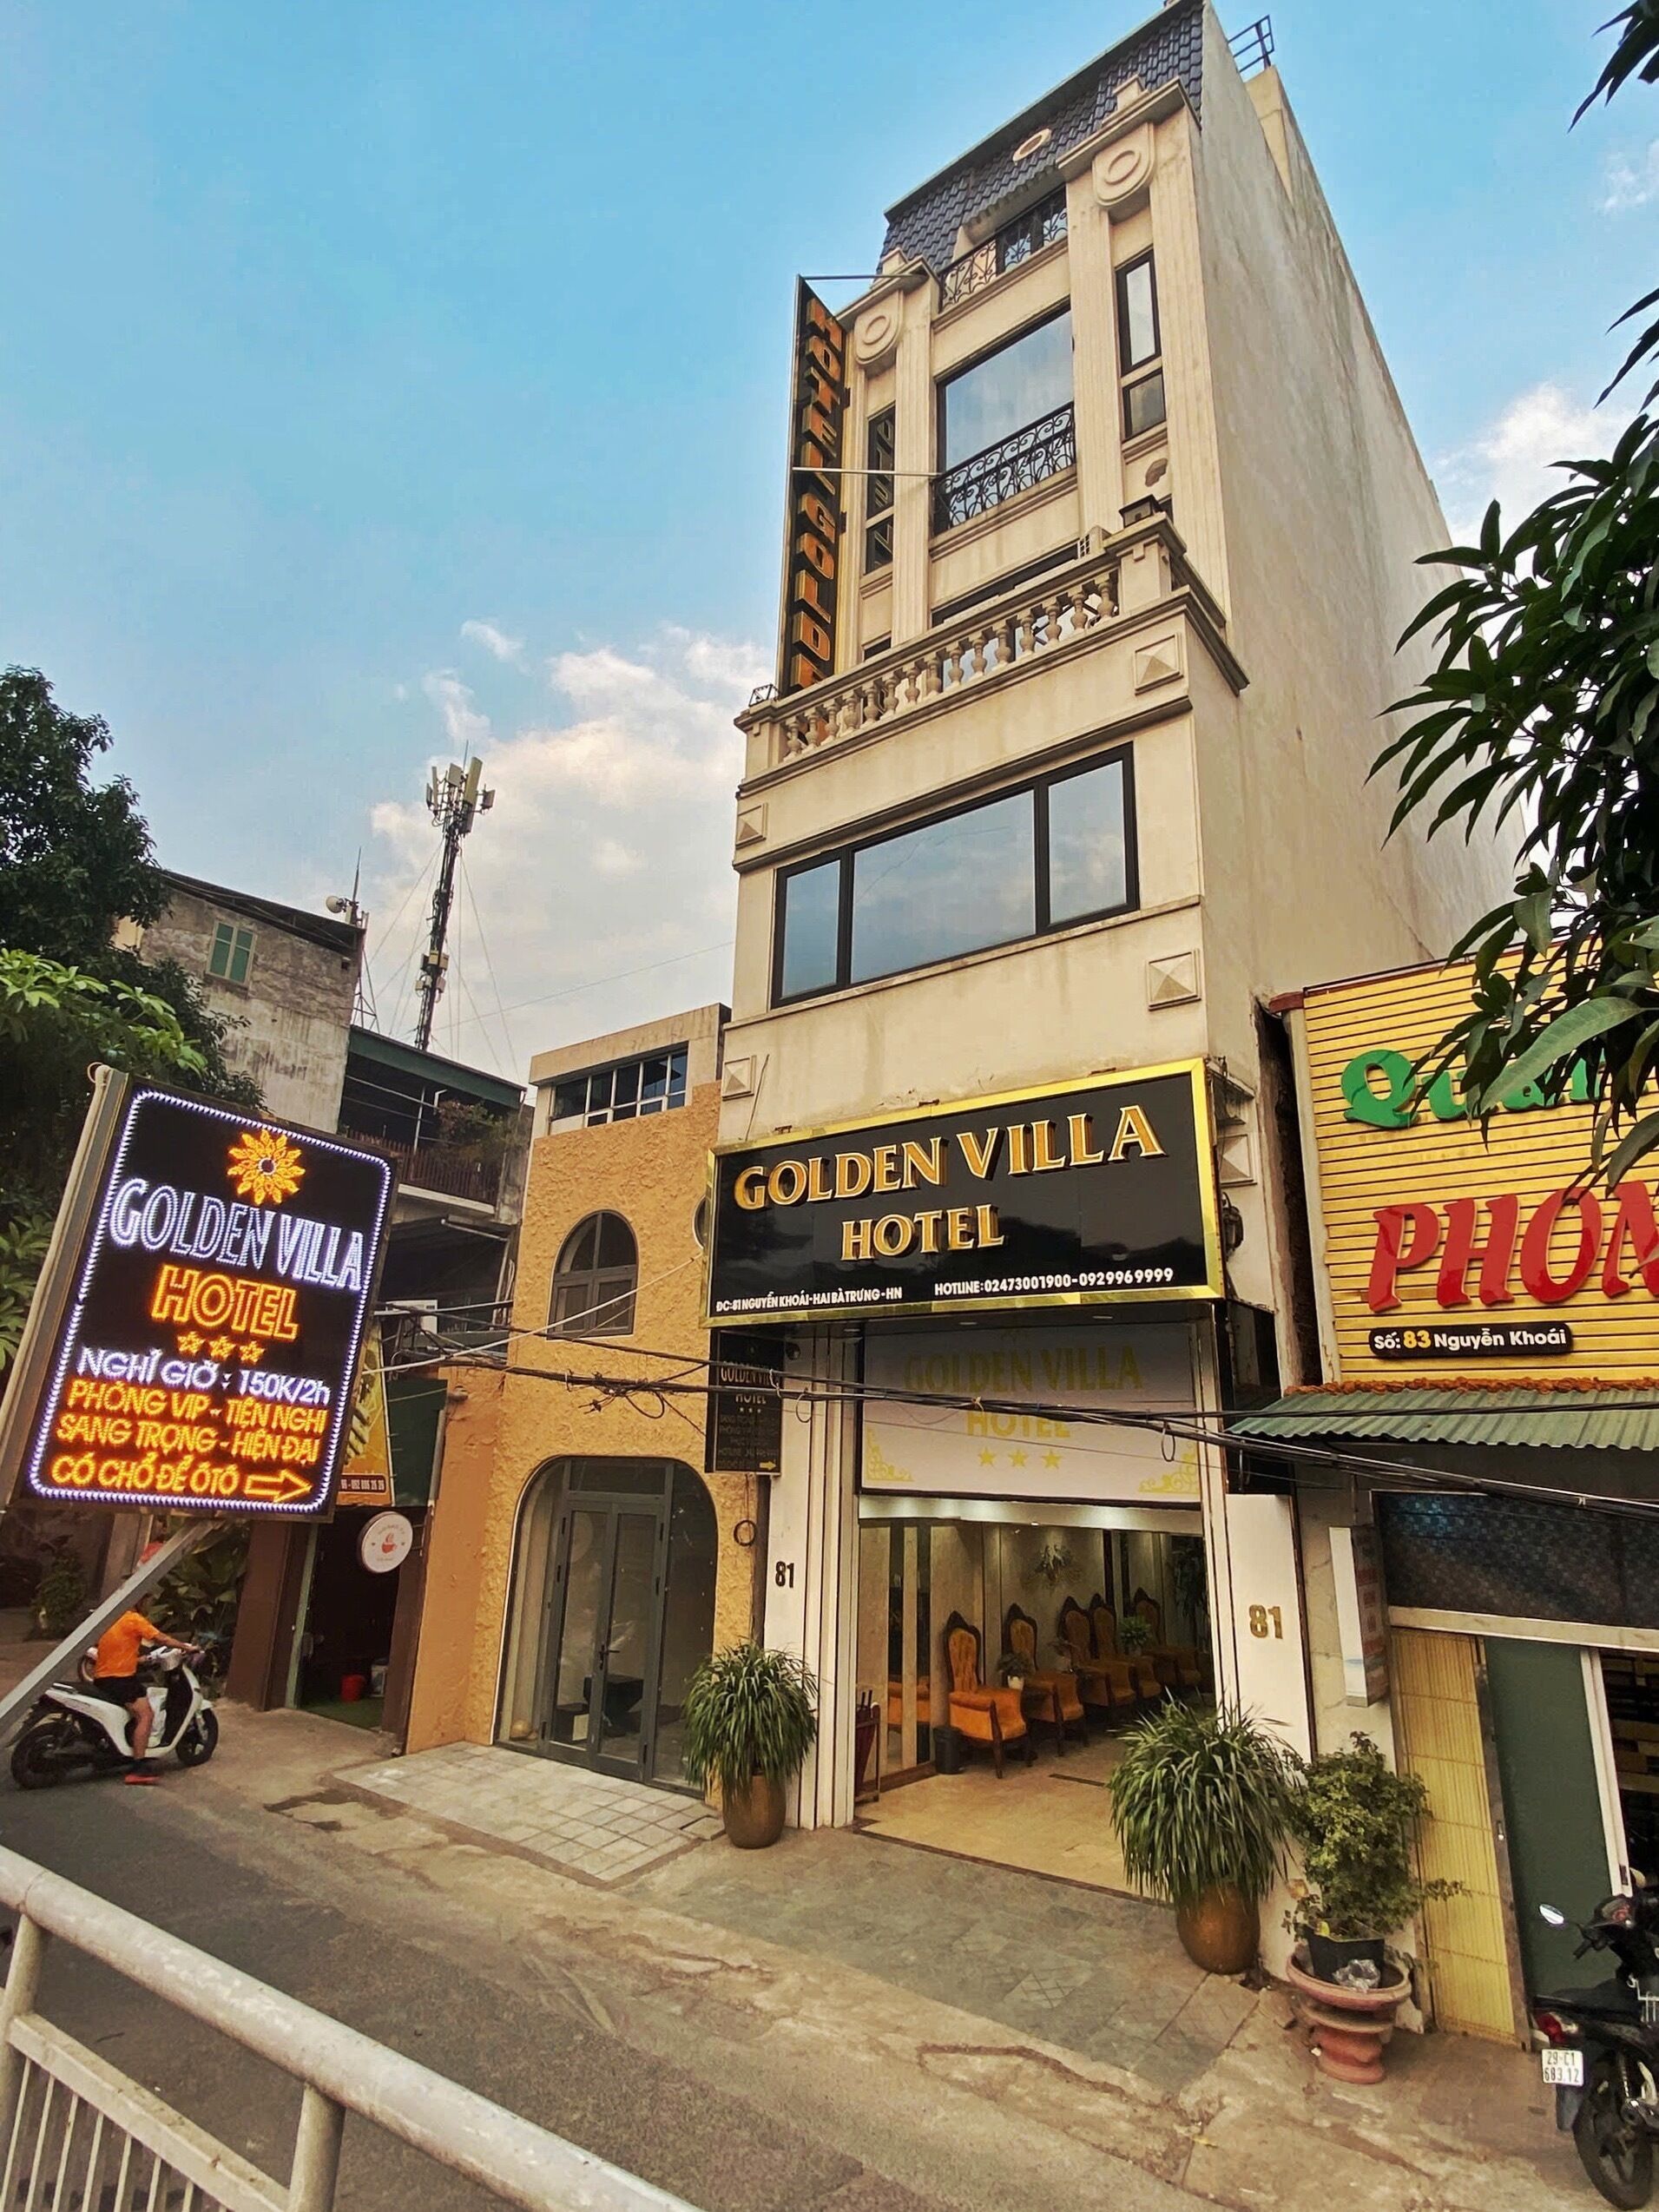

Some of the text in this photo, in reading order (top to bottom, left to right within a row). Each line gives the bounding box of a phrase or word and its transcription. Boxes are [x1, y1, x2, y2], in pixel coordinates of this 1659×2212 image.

[801, 298, 842, 496] HOTEL
[734, 1105, 1167, 1211] GOLDEN VILLA
[109, 1178, 364, 1291] GOLDEN VILLA
[840, 1204, 1005, 1261] HOTEL
[150, 1264, 299, 1340] HOTEL
[1373, 1328, 1567, 1351] Số: 83 Nguyễn Khoái
[239, 1369, 332, 1406] 150K/2h
[903, 1345, 1144, 1392] GOLDEN VILLA
[171, 1392, 211, 1421] VIP
[966, 1407, 1071, 1438] HOTEL
[56, 1413, 132, 1446] SANG
[135, 1420, 219, 1457] TRỌNG
[51, 1452, 95, 1485] CÓ
[775, 1561, 794, 1589] 81
[1248, 1604, 1283, 1639] 81
